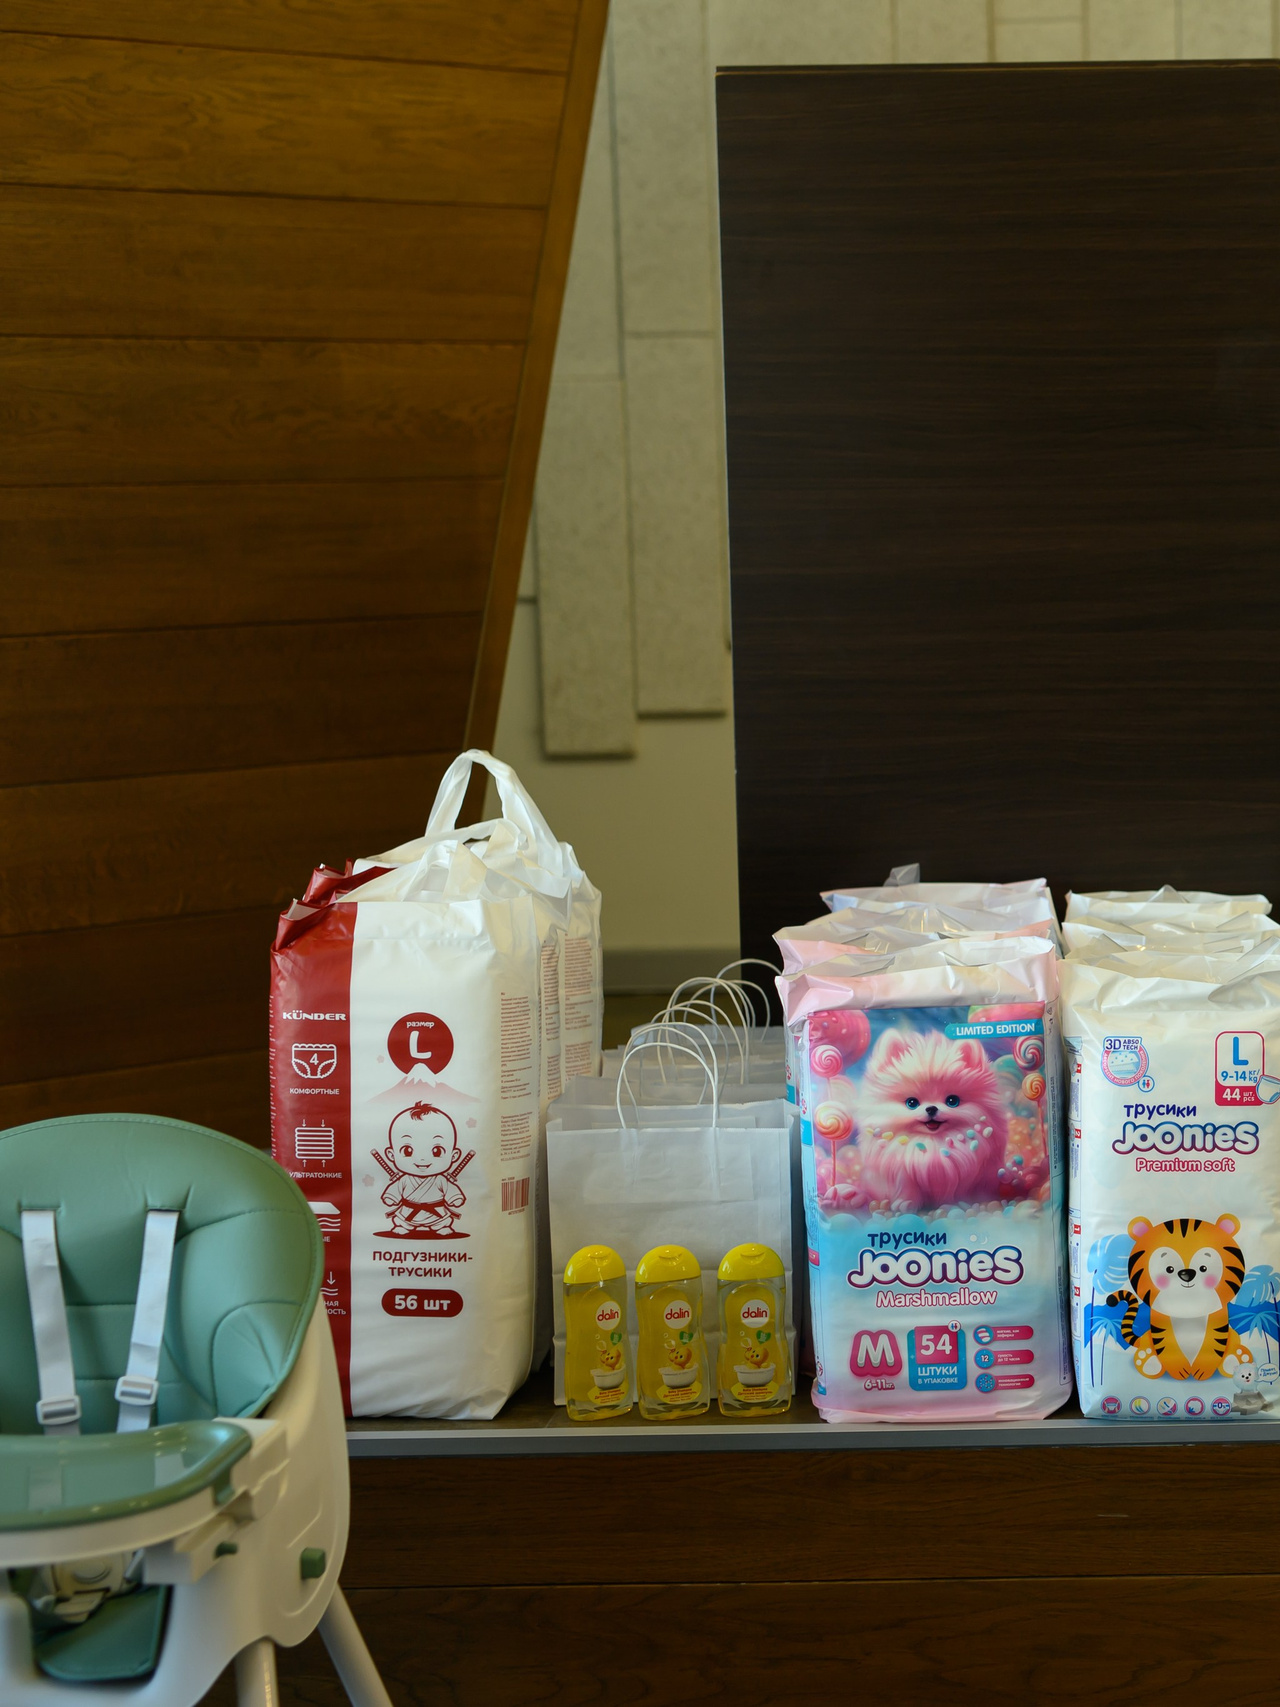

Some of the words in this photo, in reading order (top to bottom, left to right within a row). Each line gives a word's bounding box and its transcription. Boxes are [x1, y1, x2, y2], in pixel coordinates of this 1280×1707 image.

[282, 1010, 346, 1021] KÜNDER
[406, 1021, 435, 1029] размер
[956, 1025, 994, 1036] LIMITED
[996, 1023, 1035, 1035] EDITION
[409, 1030, 432, 1059] L
[1105, 1038, 1122, 1050] 3D
[1233, 1036, 1249, 1066] L
[310, 1053, 319, 1066] 4
[1221, 1070, 1247, 1081] 9-14
[289, 1088, 340, 1096] КОМФОРТНЫЕ
[1222, 1088, 1241, 1101] 44
[1123, 1103, 1197, 1120] трусики
[1135, 1157, 1202, 1173] Premium
[1203, 1158, 1236, 1172] soft
[289, 1171, 343, 1179] УЛЬТРАТОНКИЕ
[867, 1231, 947, 1250] трусики
[372, 1250, 473, 1264] ПОДГУЗНИКИ-
[388, 1266, 452, 1278] ТРУСИКИ
[394, 1294, 418, 1311] 56
[424, 1299, 451, 1311] шт
[876, 1287, 998, 1308] Marshmallow
[597, 1308, 619, 1322] dalin
[665, 1307, 690, 1321] dalin
[742, 1306, 768, 1319] dalin
[857, 1334, 895, 1367] M
[920, 1334, 953, 1356] 54
[917, 1366, 958, 1377] ШТУКИ
[925, 1377, 958, 1385] УПАКОВКЕ
